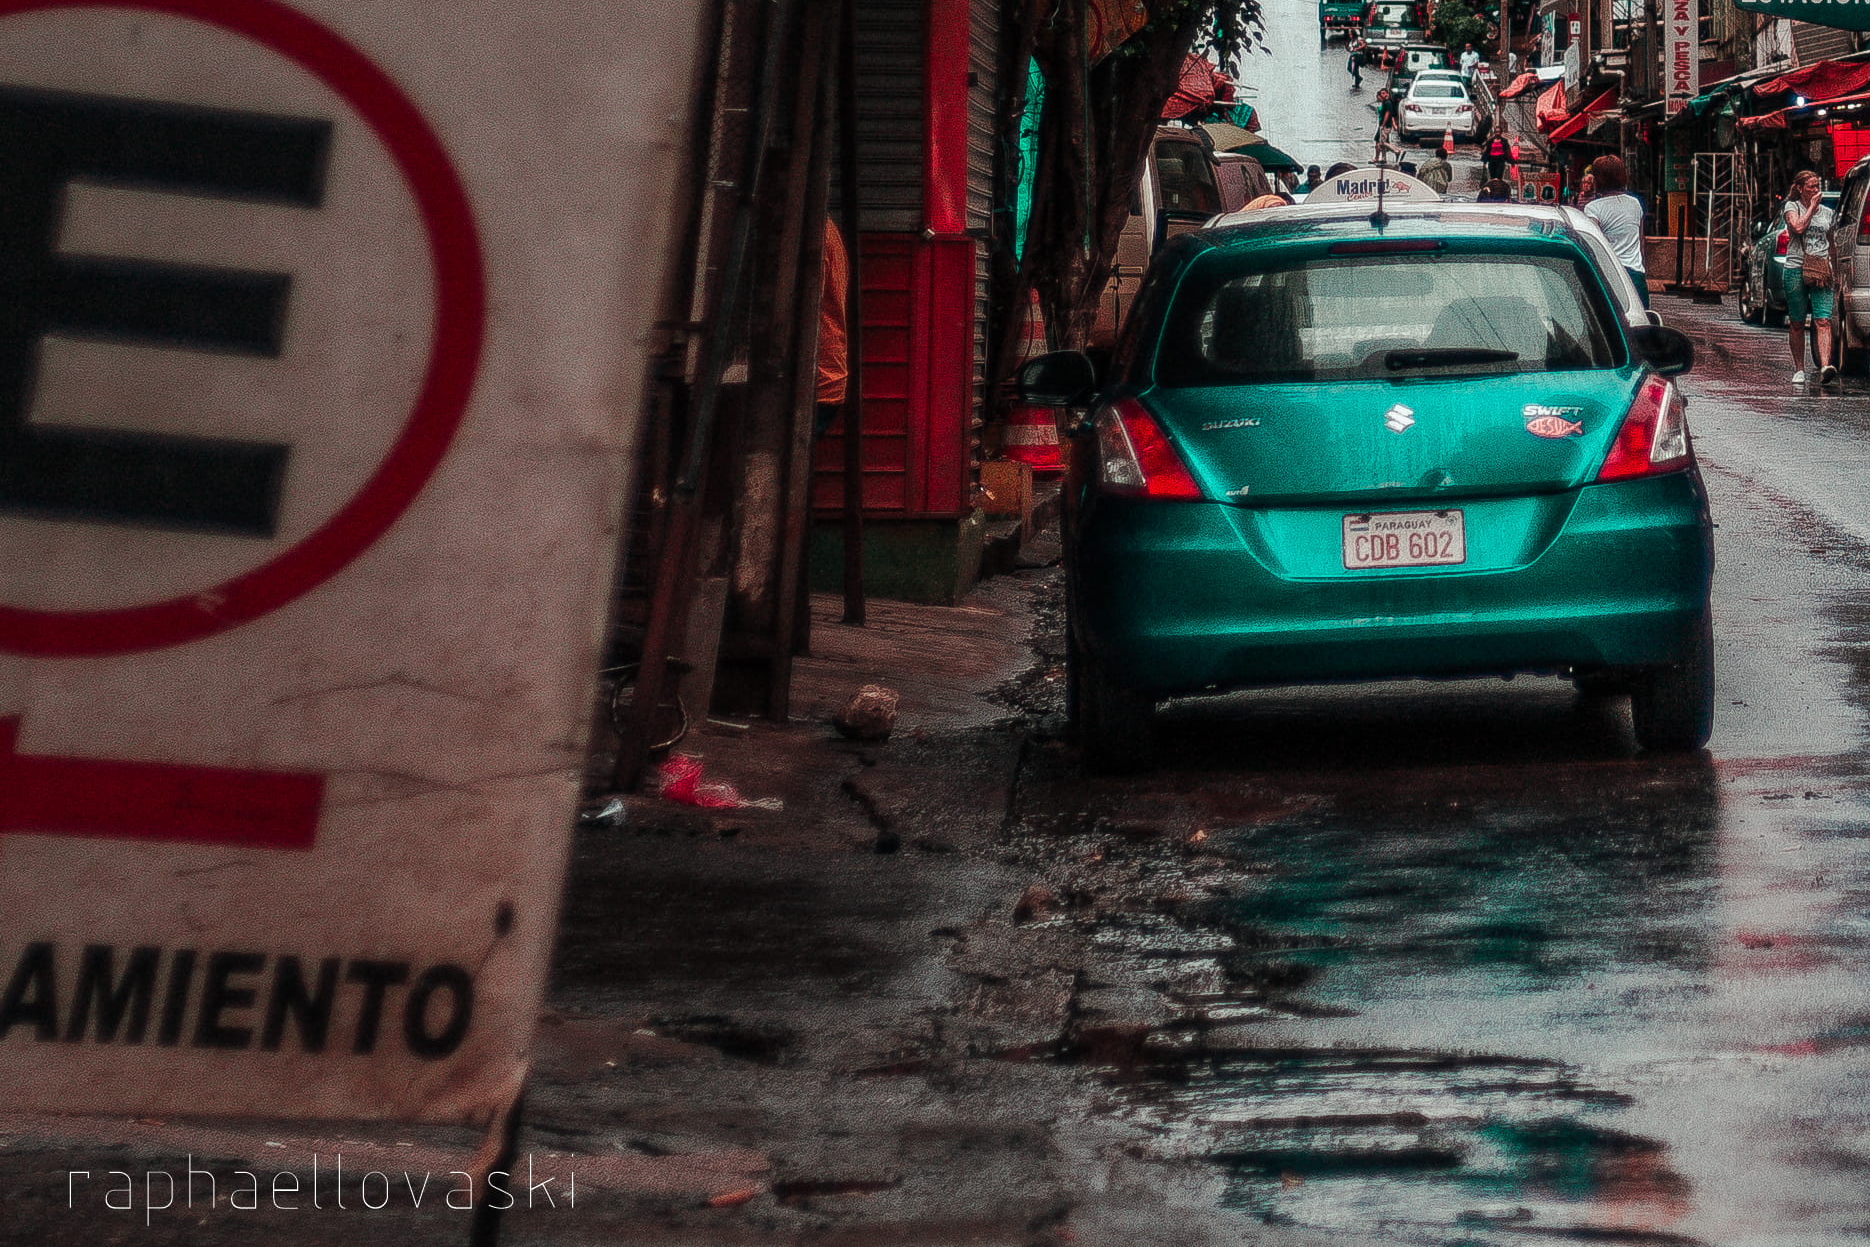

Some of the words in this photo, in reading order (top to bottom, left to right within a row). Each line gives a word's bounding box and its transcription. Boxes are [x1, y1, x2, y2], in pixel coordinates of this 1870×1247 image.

[1673, 25, 1690, 36] Y
[1673, 41, 1691, 92] PESCA
[1336, 178, 1390, 195] Madrid
[1523, 404, 1584, 416] SWIFT
[1202, 418, 1261, 431] SUZUKI
[1375, 520, 1432, 531] PARAGUAY
[1355, 533, 1400, 562] CDB
[1408, 530, 1454, 559] 602
[1, 941, 476, 1057] AMIENTO
